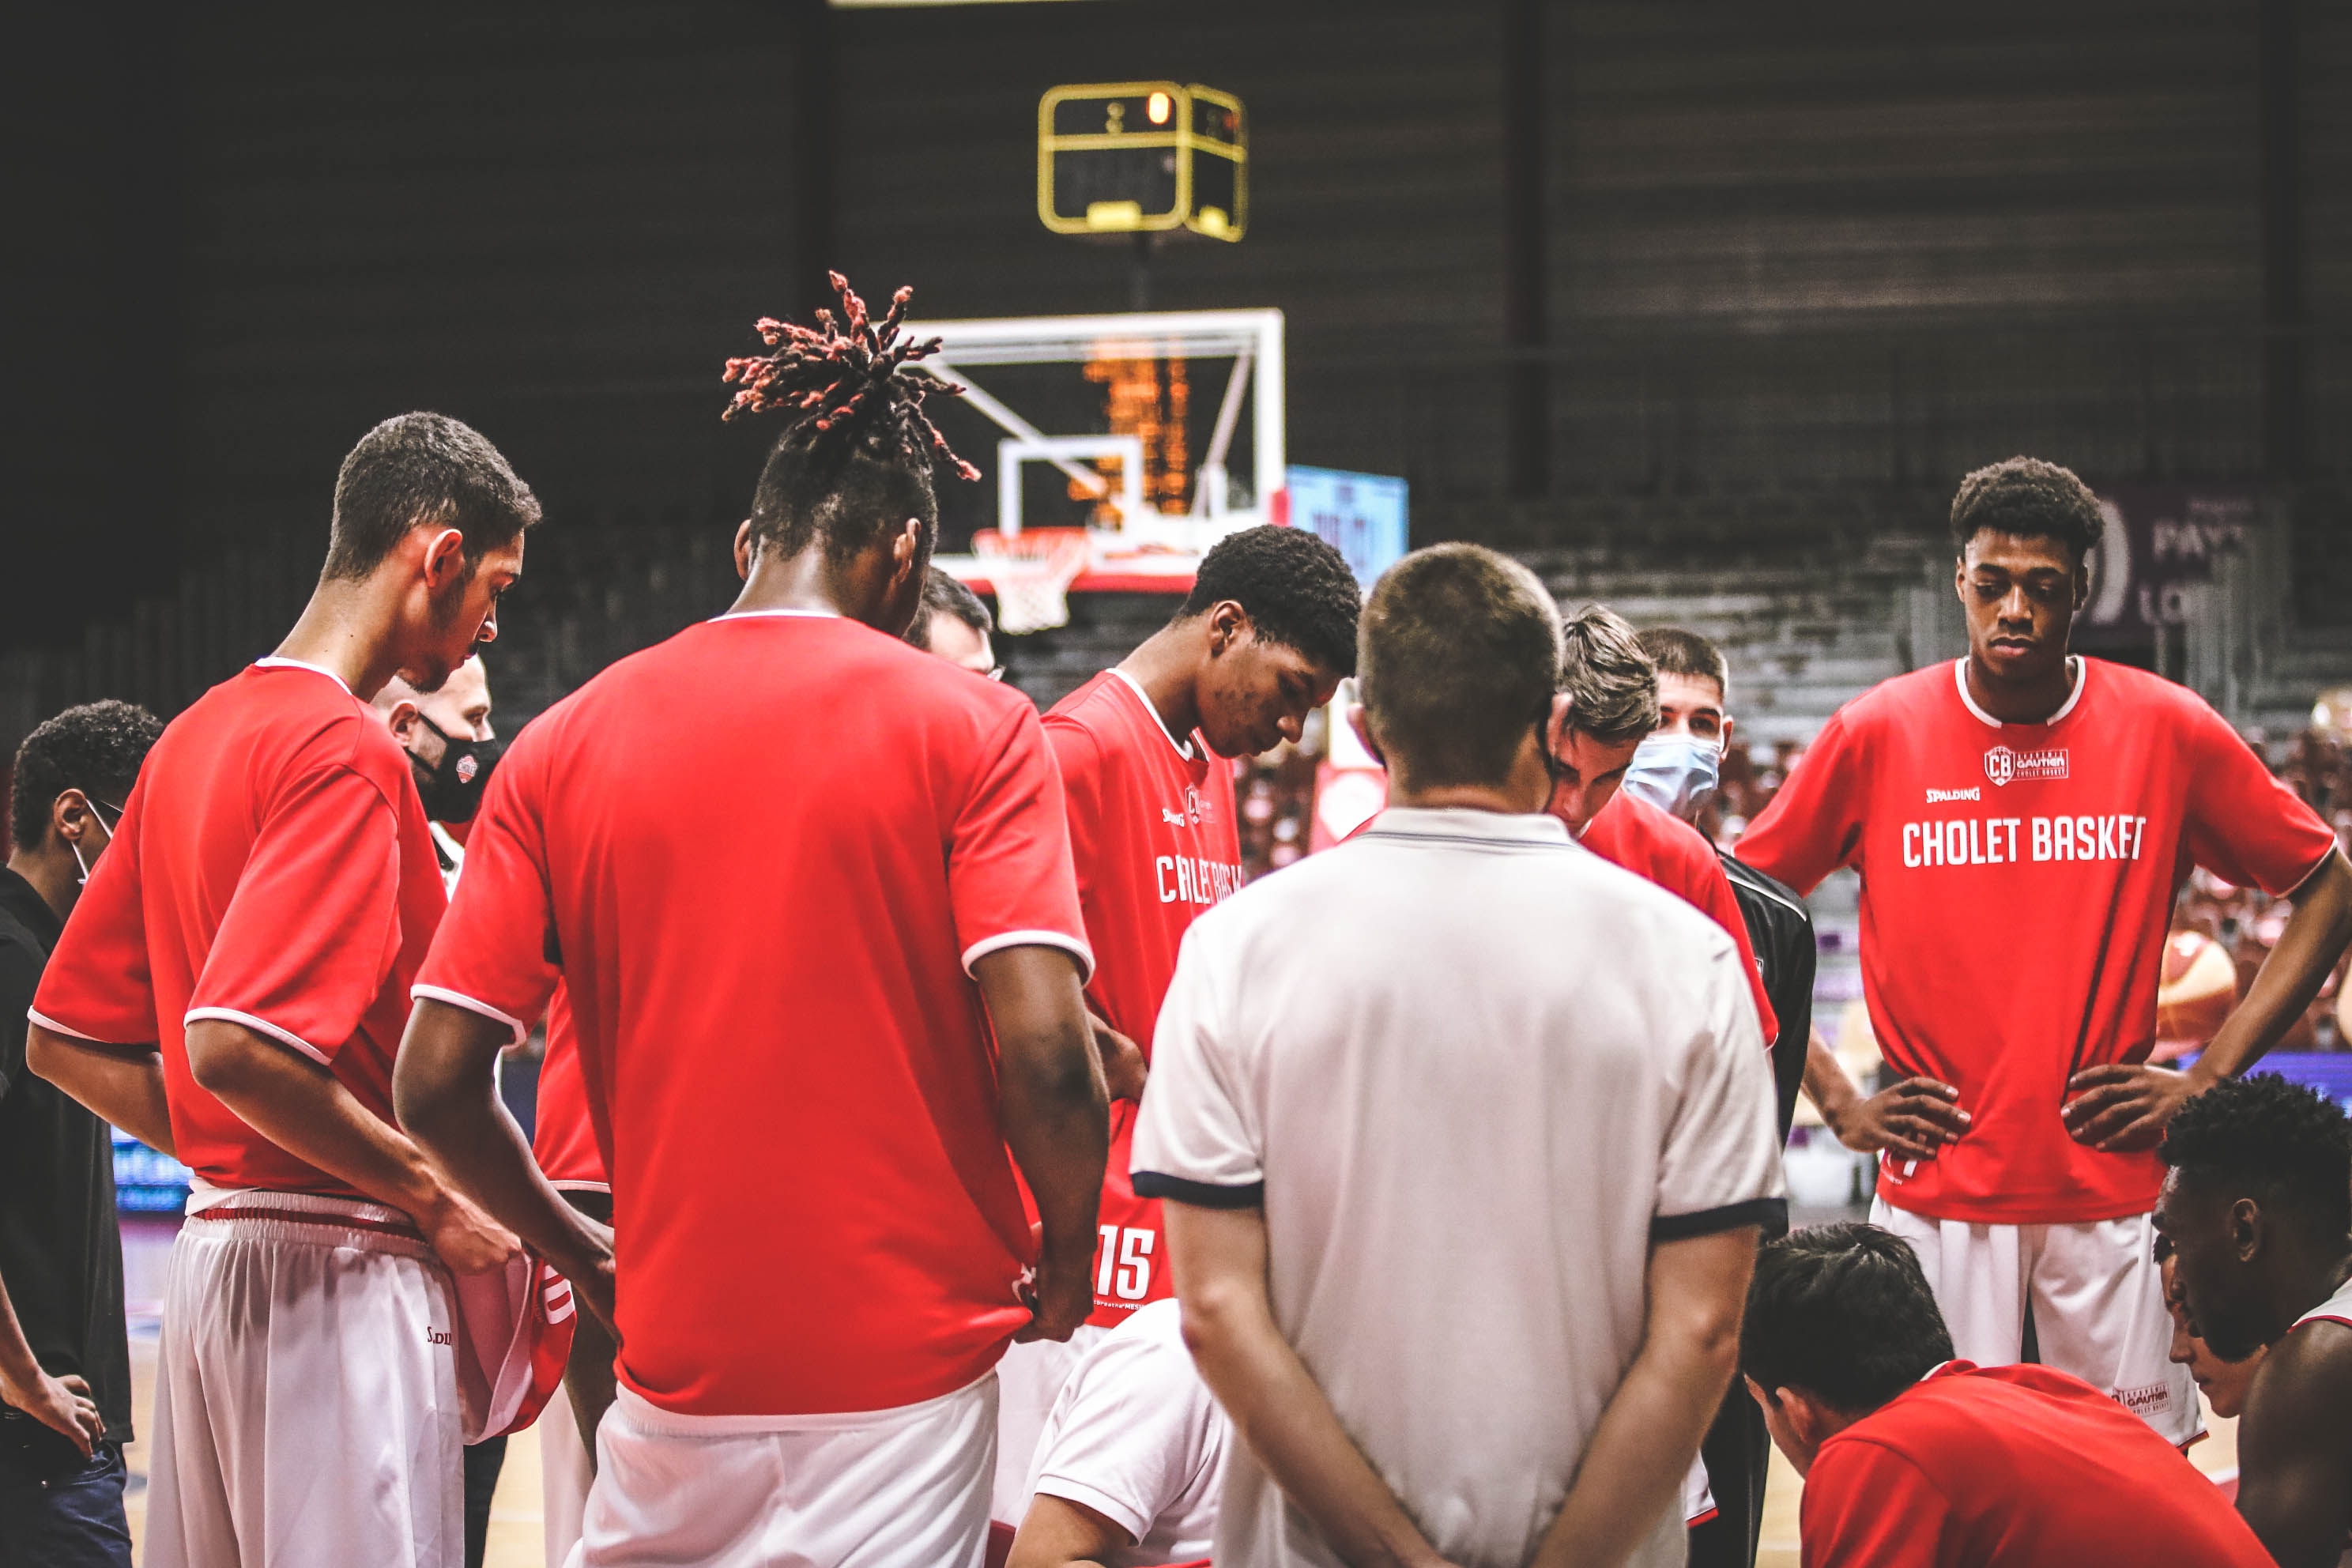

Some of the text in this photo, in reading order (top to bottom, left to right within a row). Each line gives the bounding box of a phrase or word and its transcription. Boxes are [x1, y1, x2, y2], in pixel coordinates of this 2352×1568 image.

[1988, 754, 2011, 777] CB
[1926, 787, 1980, 803] SPALDING
[1902, 814, 2147, 868] CHOLET BASKET
[1097, 1225, 1155, 1300] 15
